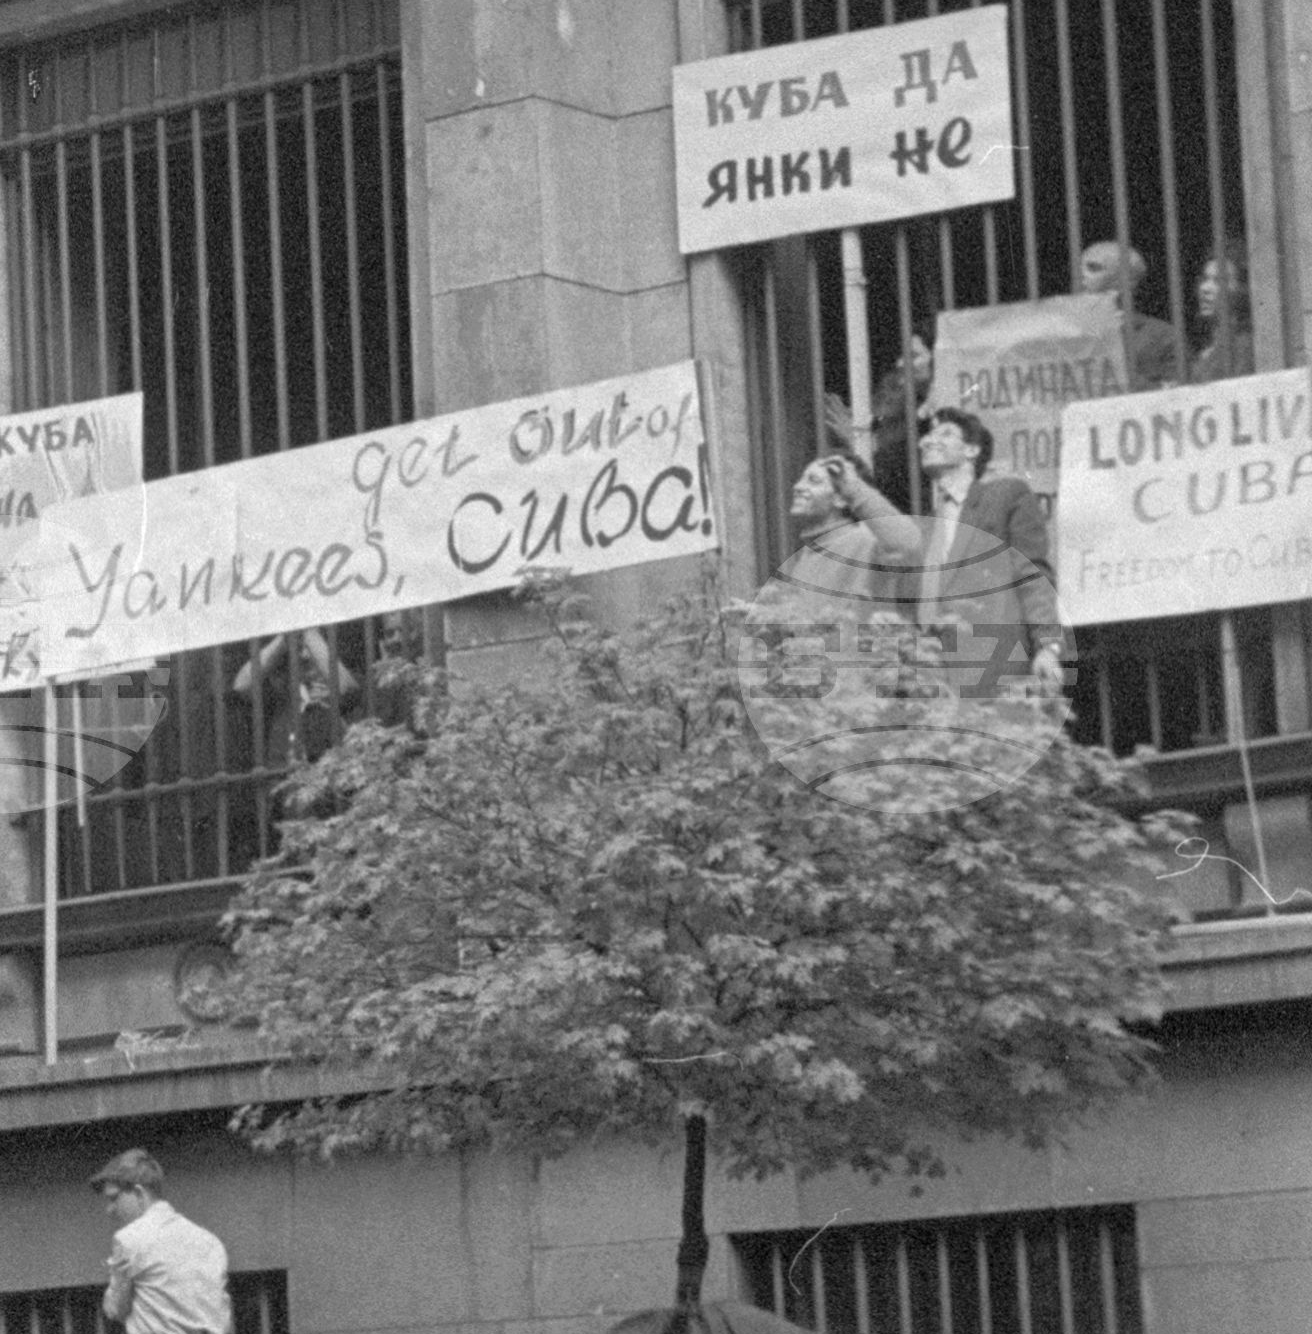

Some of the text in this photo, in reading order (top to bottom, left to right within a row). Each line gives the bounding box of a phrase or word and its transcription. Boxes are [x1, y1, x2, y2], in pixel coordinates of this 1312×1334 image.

[704, 39, 979, 128] КУБА ДА
[701, 146, 853, 210] ЯНКИ
[1089, 394, 1312, 470] LONG LIV
[353, 424, 480, 530] get
[65, 531, 407, 641] Yankees,
